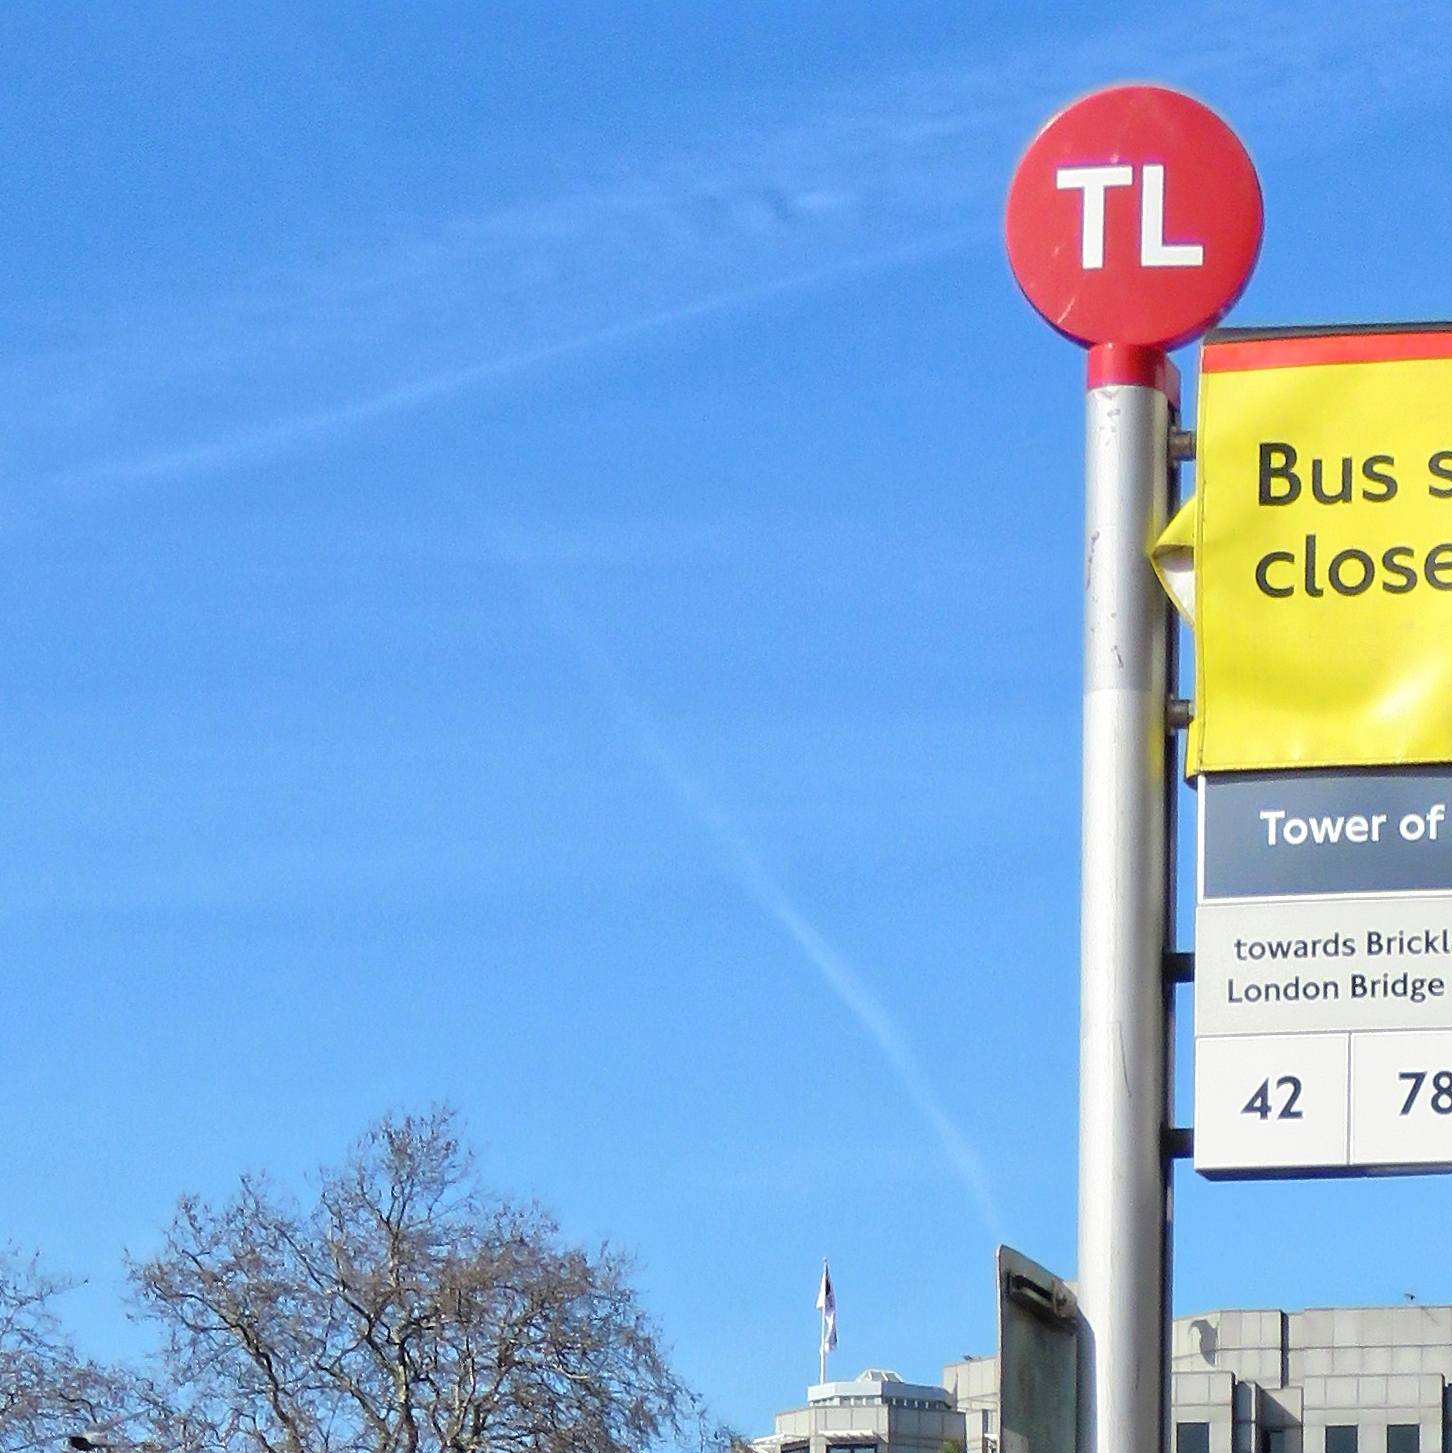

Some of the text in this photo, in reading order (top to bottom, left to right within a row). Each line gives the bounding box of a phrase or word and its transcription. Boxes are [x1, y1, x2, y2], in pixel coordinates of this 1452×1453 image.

[1056, 163, 1204, 270] TL
[1257, 442, 1398, 507] Bus
[1259, 808, 1387, 846] Tower
[1399, 804, 1446, 842] of
[1233, 931, 1356, 961] towards
[1226, 975, 1340, 1004] London
[1349, 972, 1446, 1005] Bridge
[1239, 1074, 1304, 1121] 42
